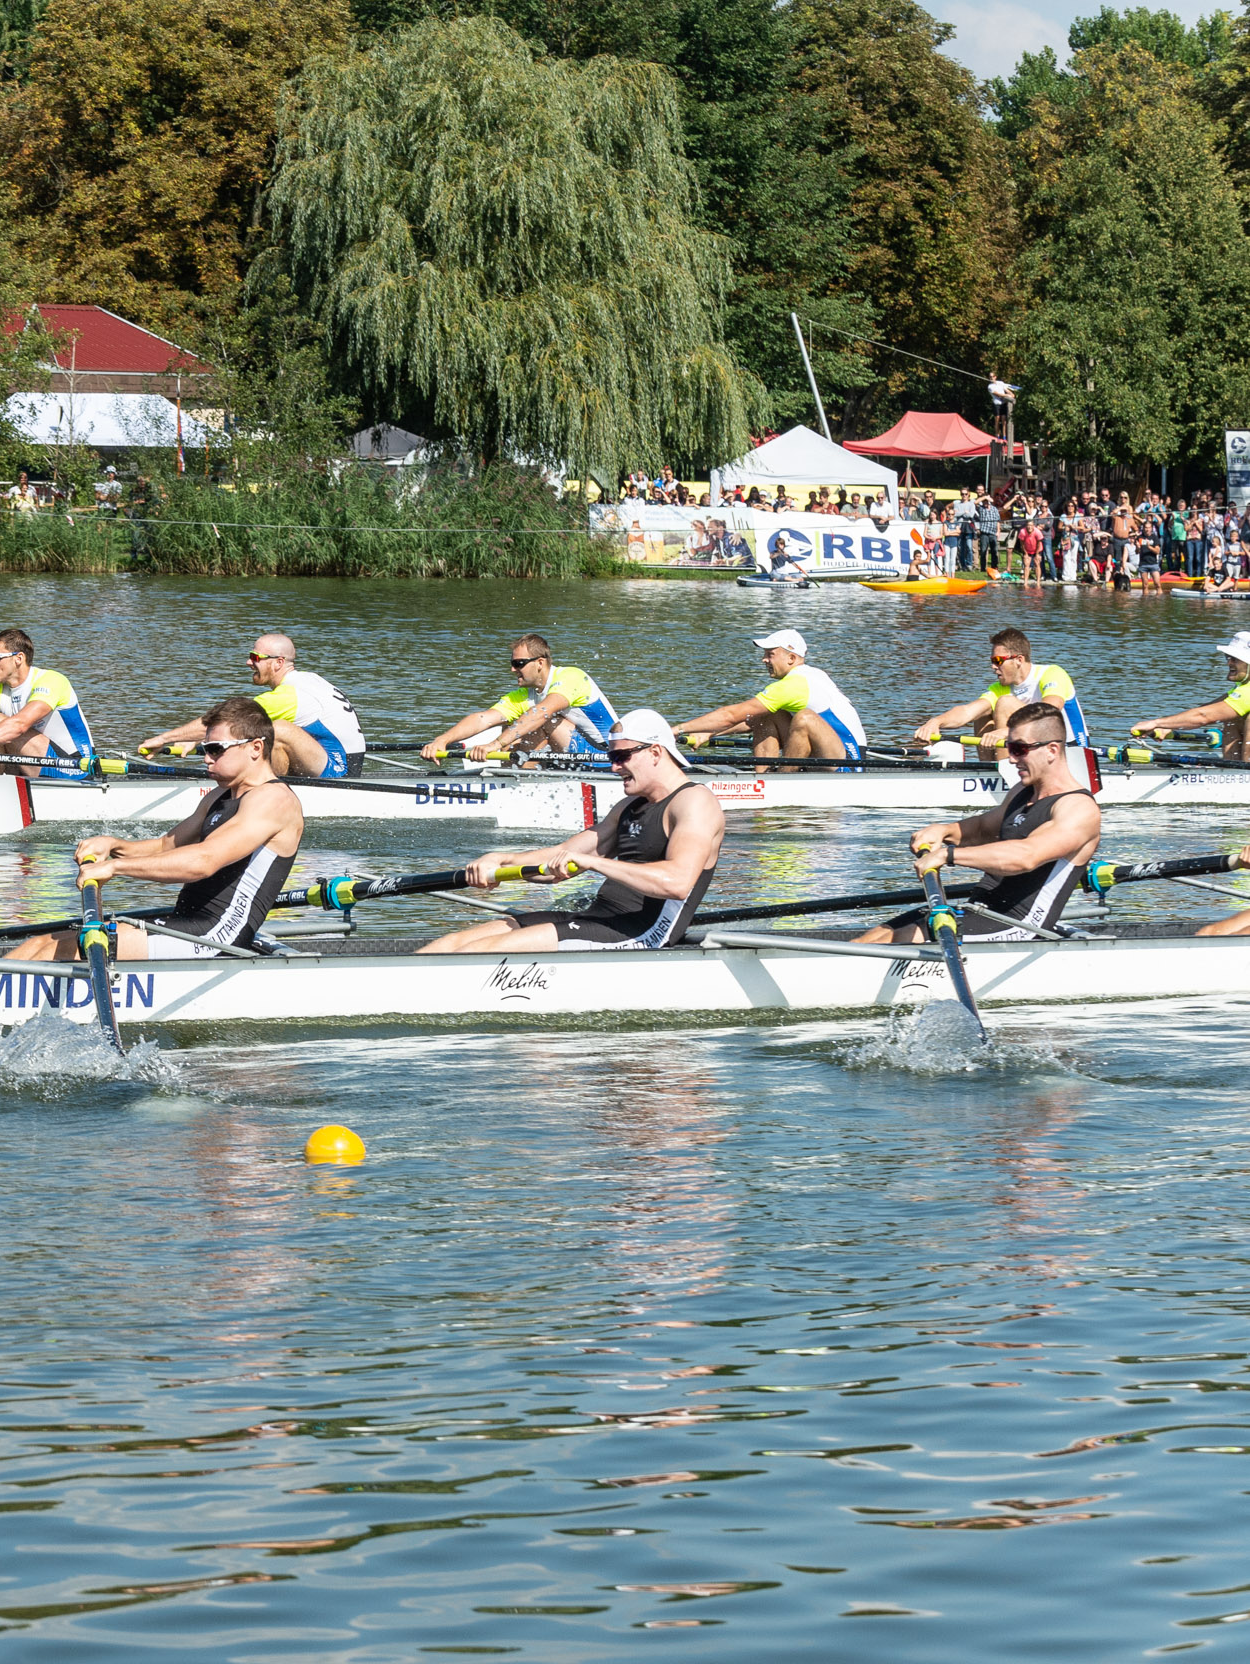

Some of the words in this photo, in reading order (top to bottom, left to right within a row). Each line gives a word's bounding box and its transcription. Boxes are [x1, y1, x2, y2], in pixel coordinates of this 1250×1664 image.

[823, 533, 911, 565] RBL
[59, 758, 75, 767] RBL
[1182, 774, 1205, 783] RBL
[712, 782, 752, 793] hilzinger
[291, 889, 306, 899] RBL
[481, 957, 549, 991] Melitta
[886, 959, 946, 979] Melitta
